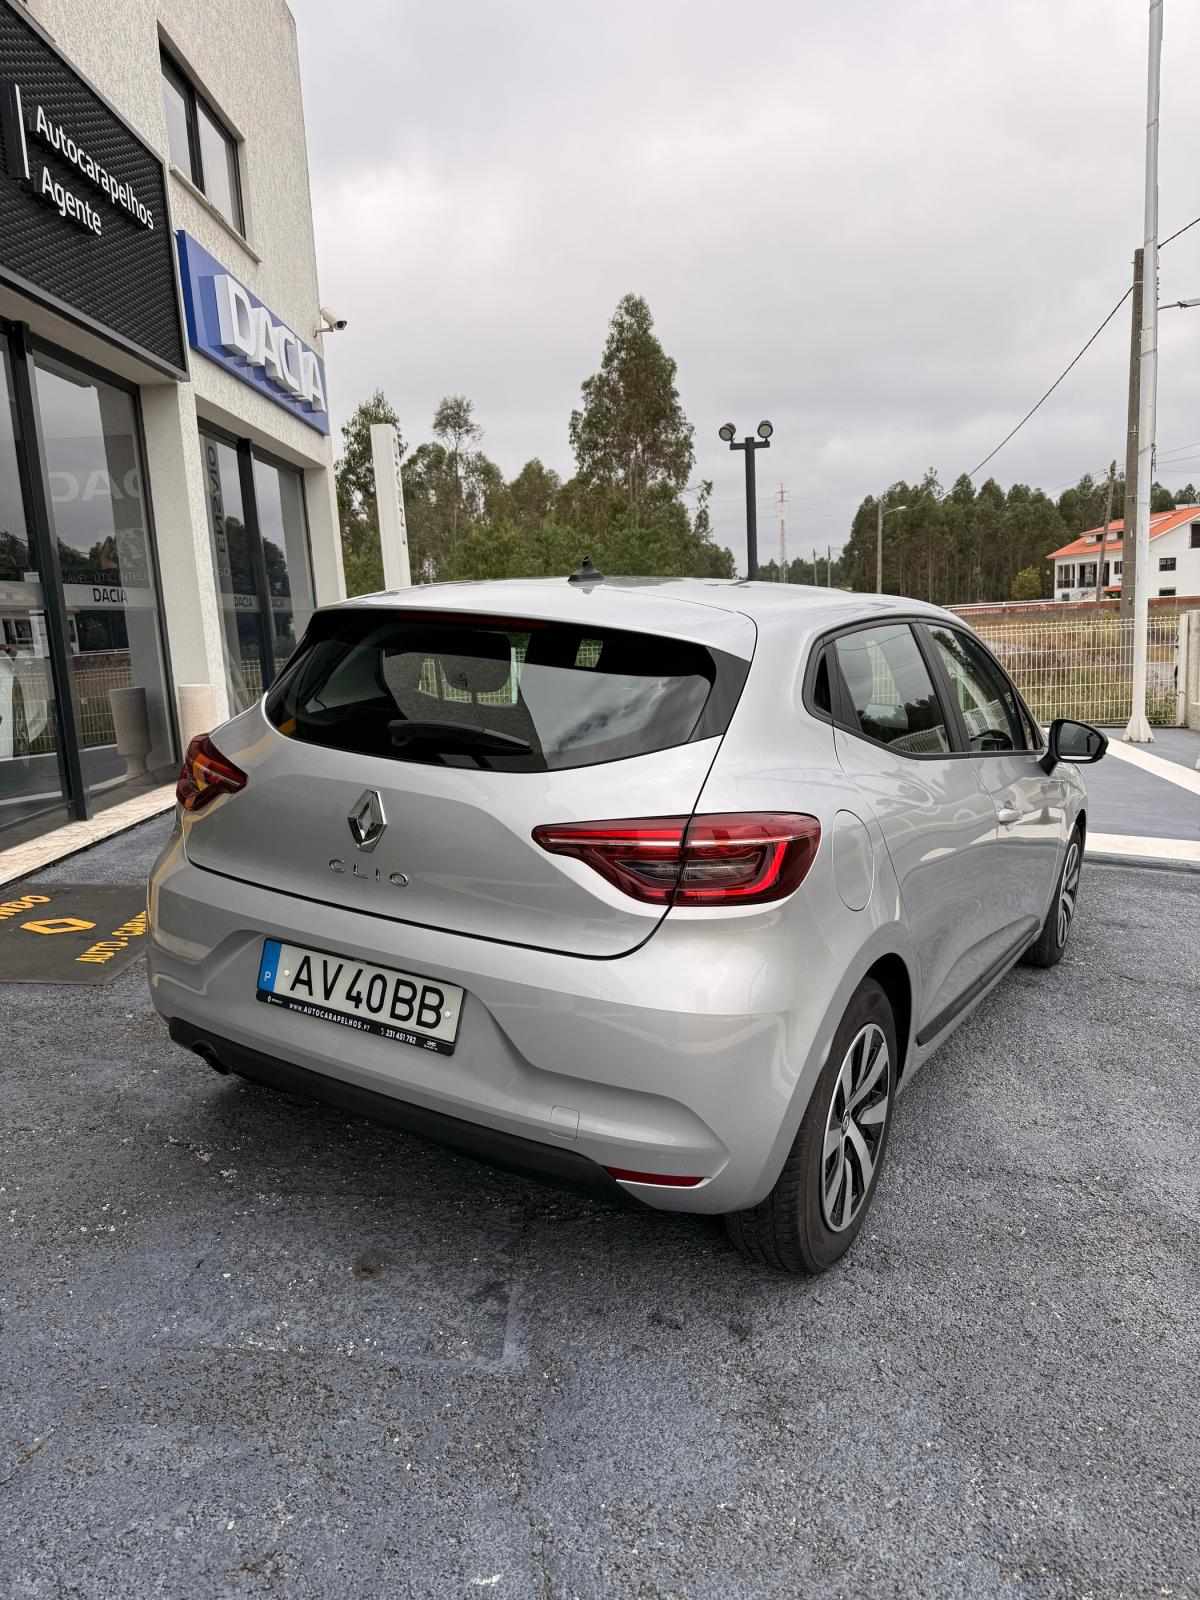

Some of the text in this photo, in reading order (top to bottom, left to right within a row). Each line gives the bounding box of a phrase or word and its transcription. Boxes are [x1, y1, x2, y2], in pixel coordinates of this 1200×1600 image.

[36, 104, 154, 230] Autocarapelhos
[42, 166, 102, 236] Agente
[214, 274, 327, 413] DACIA
[92, 587, 128, 603] DACIA
[328, 859, 409, 888] CLIO
